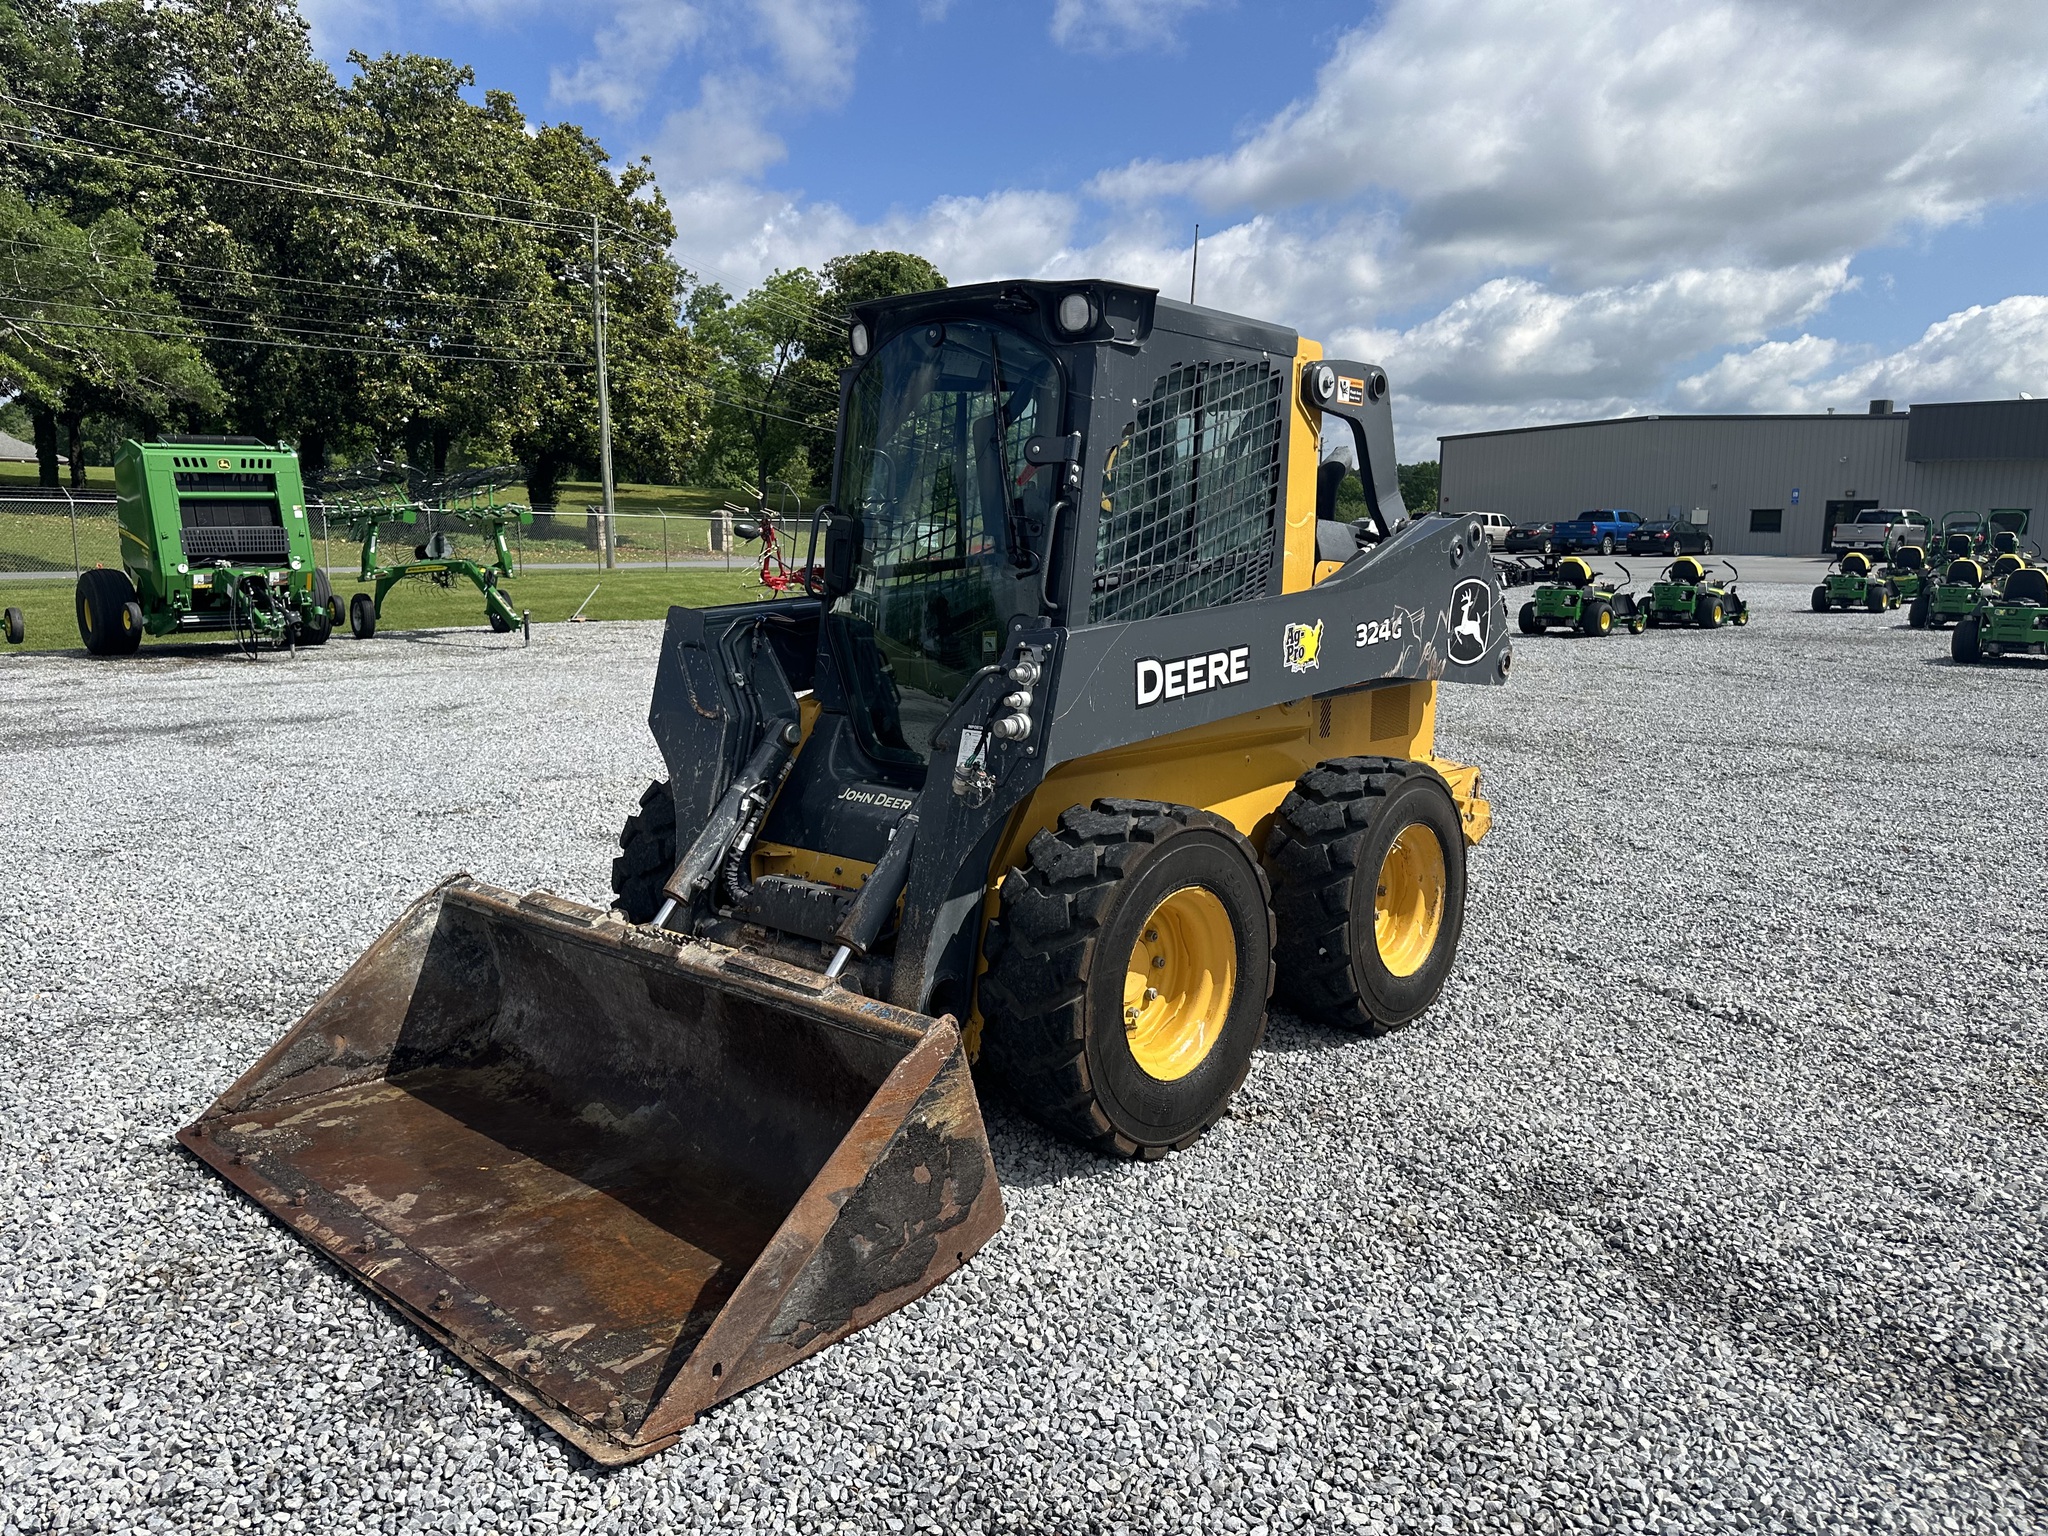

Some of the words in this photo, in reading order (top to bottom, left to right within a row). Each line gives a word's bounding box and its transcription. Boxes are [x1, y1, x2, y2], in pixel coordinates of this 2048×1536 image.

[1285, 626, 1305, 647] Ag-
[1356, 618, 1402, 648] 324G
[1285, 645, 1305, 663] Pro
[1136, 646, 1249, 706] DEERE
[838, 787, 875, 804] JOHN
[873, 793, 912, 811] DEER
